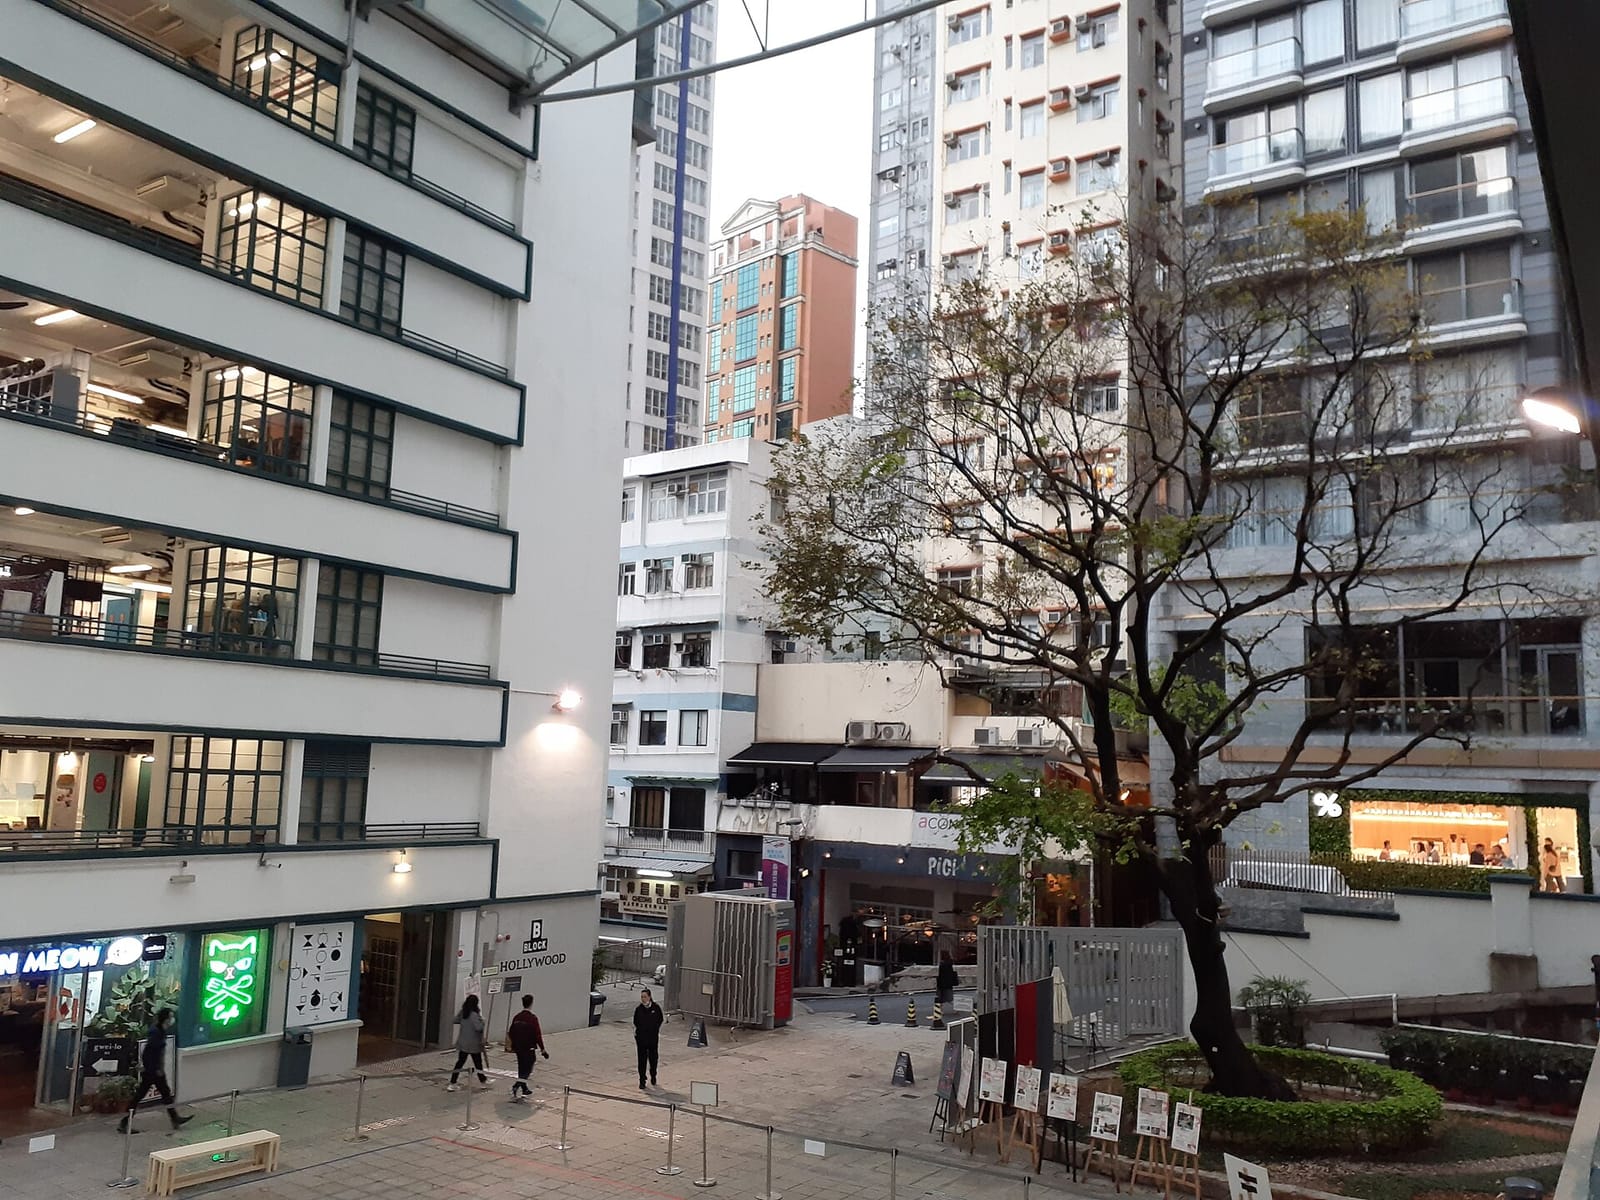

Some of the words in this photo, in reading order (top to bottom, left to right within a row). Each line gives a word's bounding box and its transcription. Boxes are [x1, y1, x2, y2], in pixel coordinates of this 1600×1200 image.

[532, 922, 541, 939] B
[523, 940, 546, 952] BLOCK
[23, 946, 100, 972] MEOW
[500, 953, 566, 972] HOLLYWOOD
